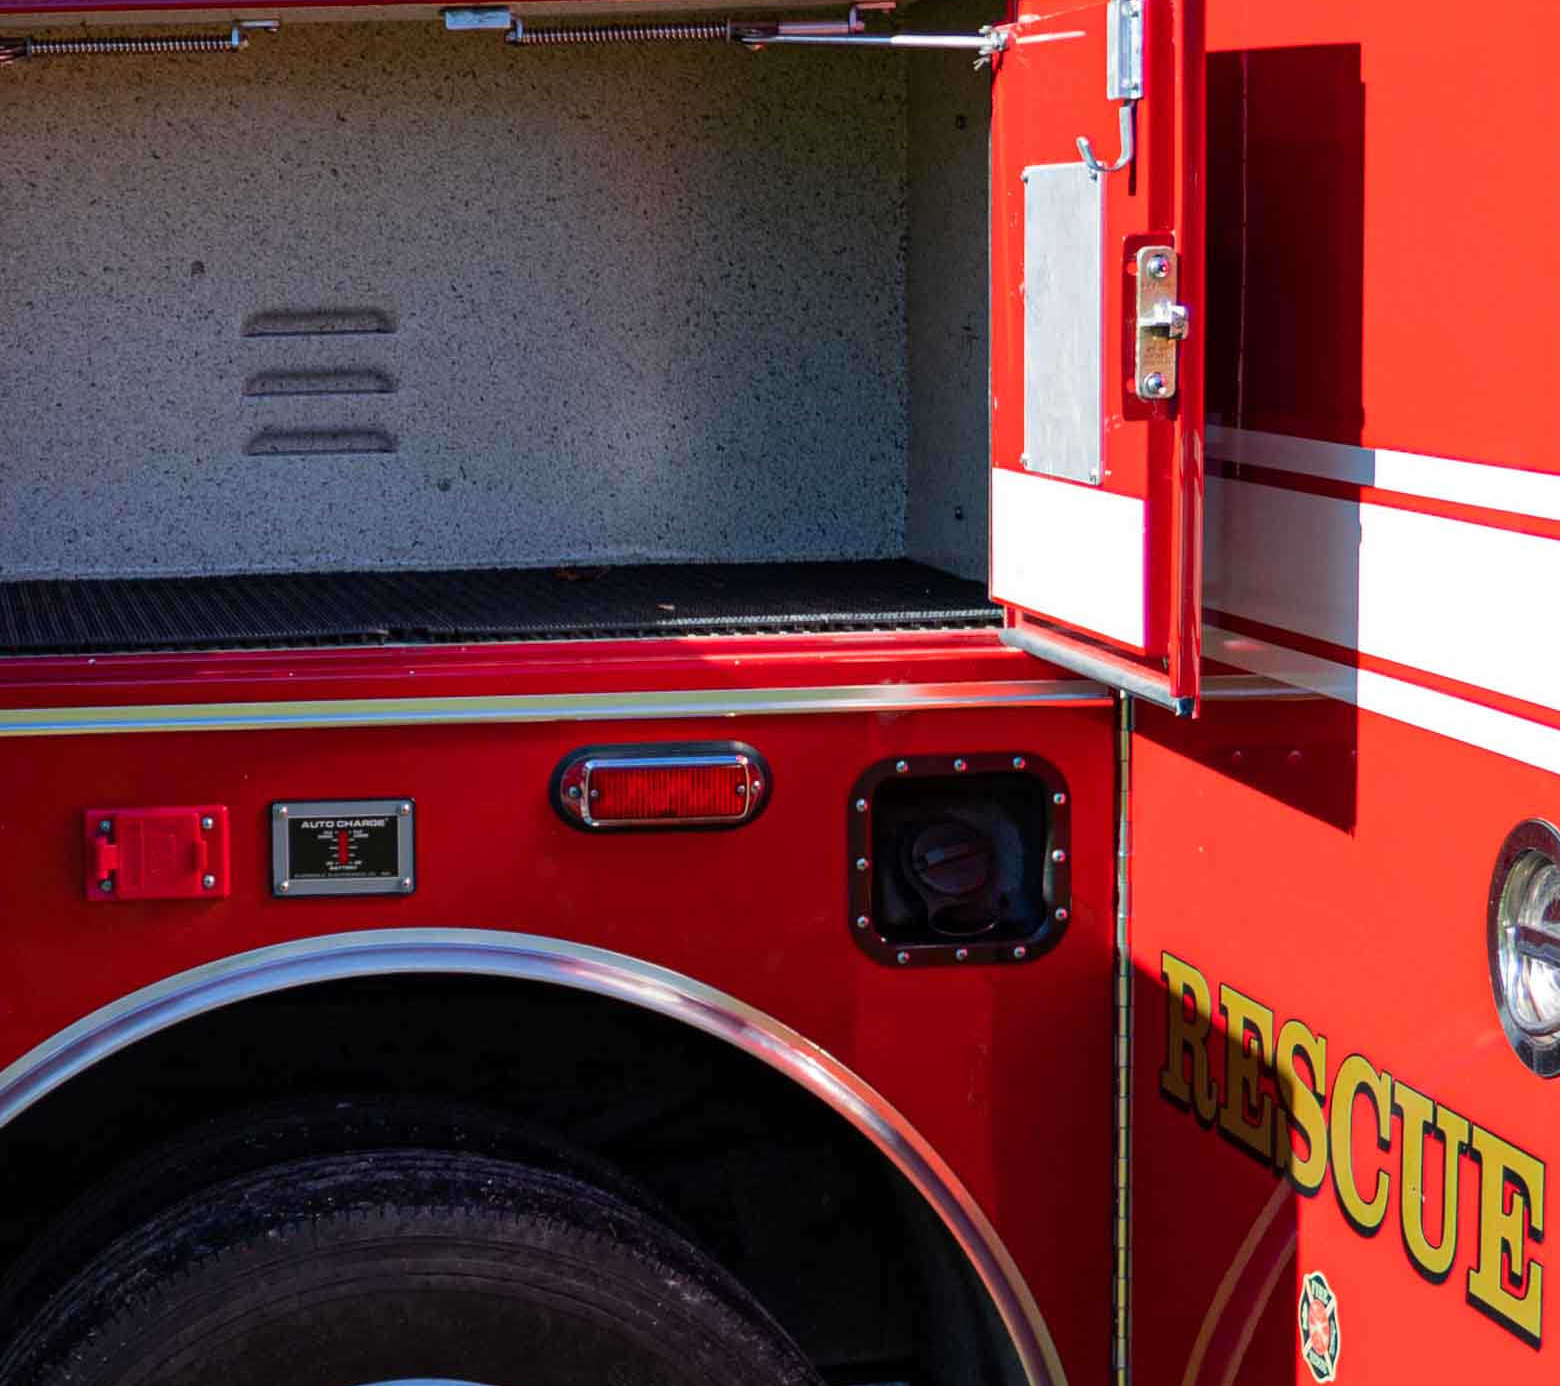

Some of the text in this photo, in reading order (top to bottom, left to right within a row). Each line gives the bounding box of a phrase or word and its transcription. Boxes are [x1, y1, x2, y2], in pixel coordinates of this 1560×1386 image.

[301, 819, 385, 829] AUTO CHARGE
[1159, 949, 1546, 1351] RESCUE
